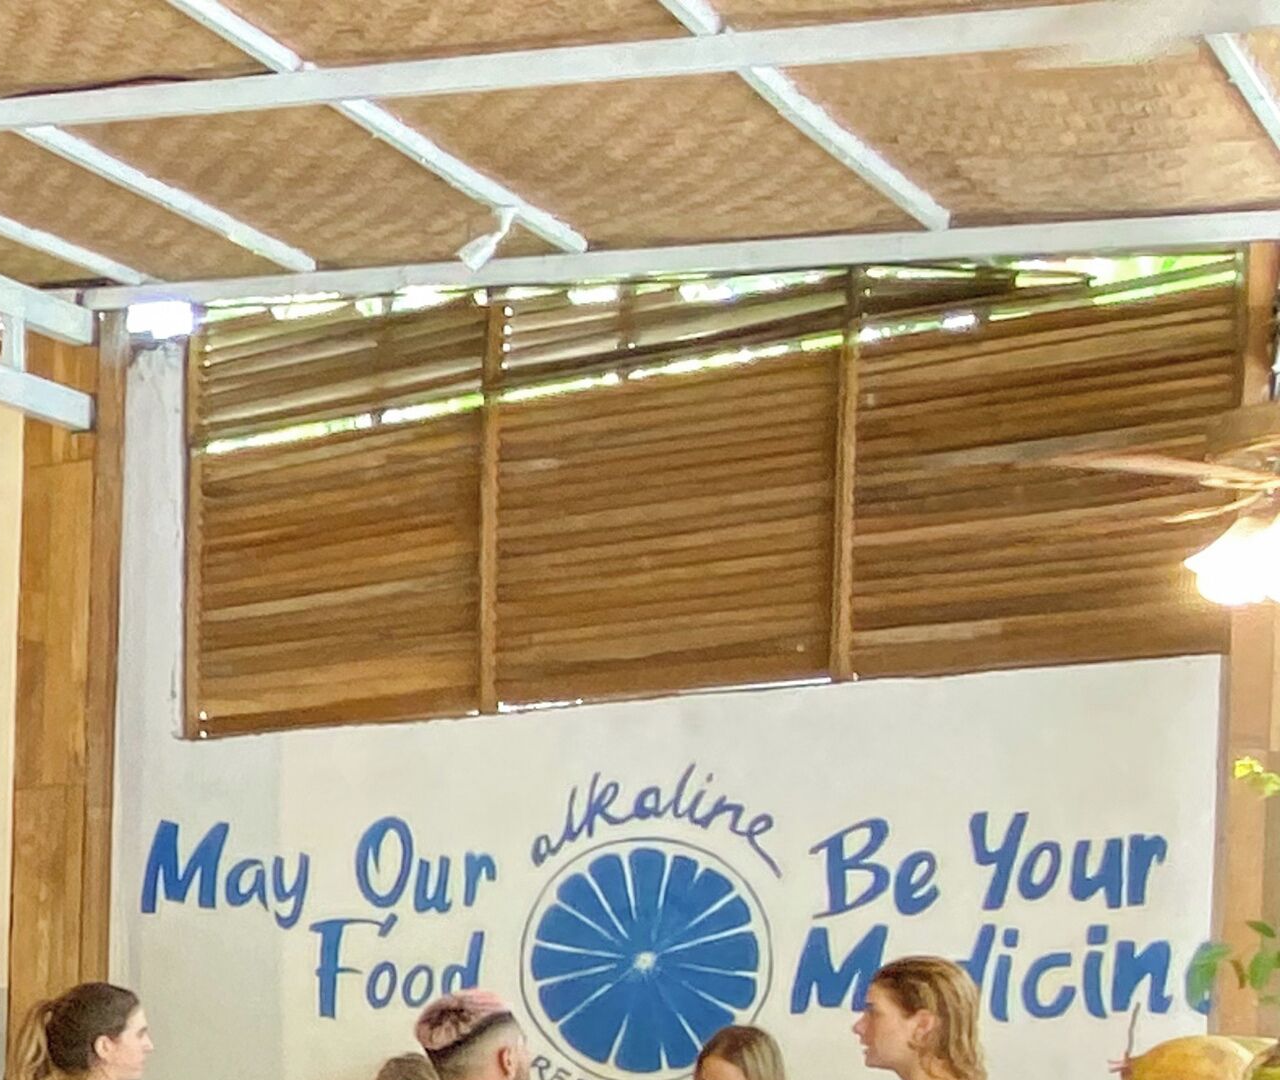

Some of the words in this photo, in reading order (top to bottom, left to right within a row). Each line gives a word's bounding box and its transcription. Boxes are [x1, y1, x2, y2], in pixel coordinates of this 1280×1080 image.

[140, 819, 310, 930] May
[354, 816, 497, 914] Our
[531, 763, 782, 879] alkaline
[809, 817, 941, 919] Be
[969, 811, 1168, 910] Your
[308, 912, 485, 1020] Food
[790, 923, 1214, 1022] Mdicin
